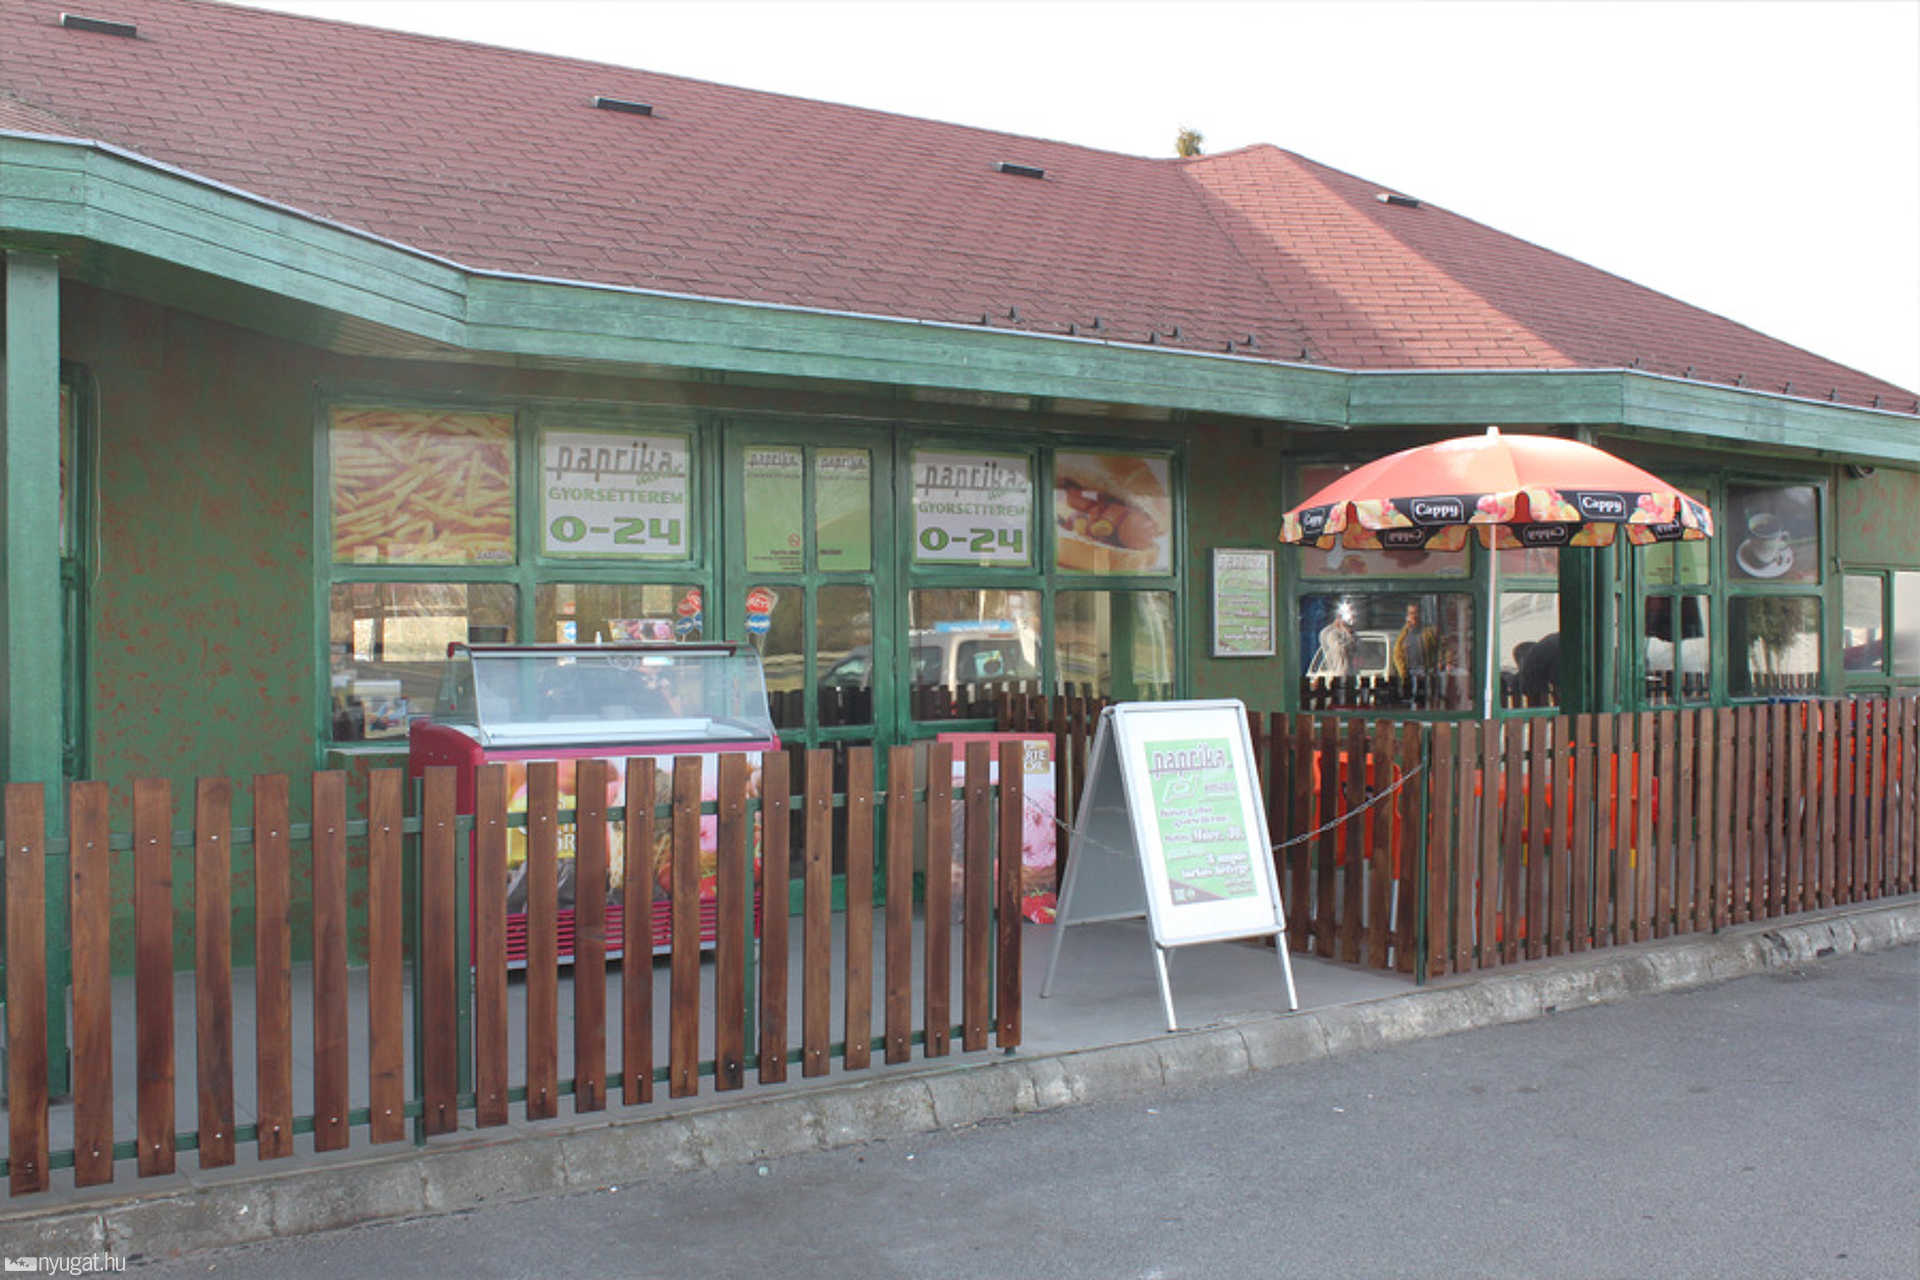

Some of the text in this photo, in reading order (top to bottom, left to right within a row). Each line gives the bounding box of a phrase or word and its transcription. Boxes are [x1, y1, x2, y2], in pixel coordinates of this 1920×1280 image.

[557, 441, 673, 482] paprika
[924, 461, 1017, 497] paprika
[1415, 502, 1460, 518] Cappy
[1583, 496, 1622, 513] Cappy
[550, 515, 682, 546] 0-24
[919, 526, 1024, 554] 0-24
[1152, 742, 1226, 781] paprika
